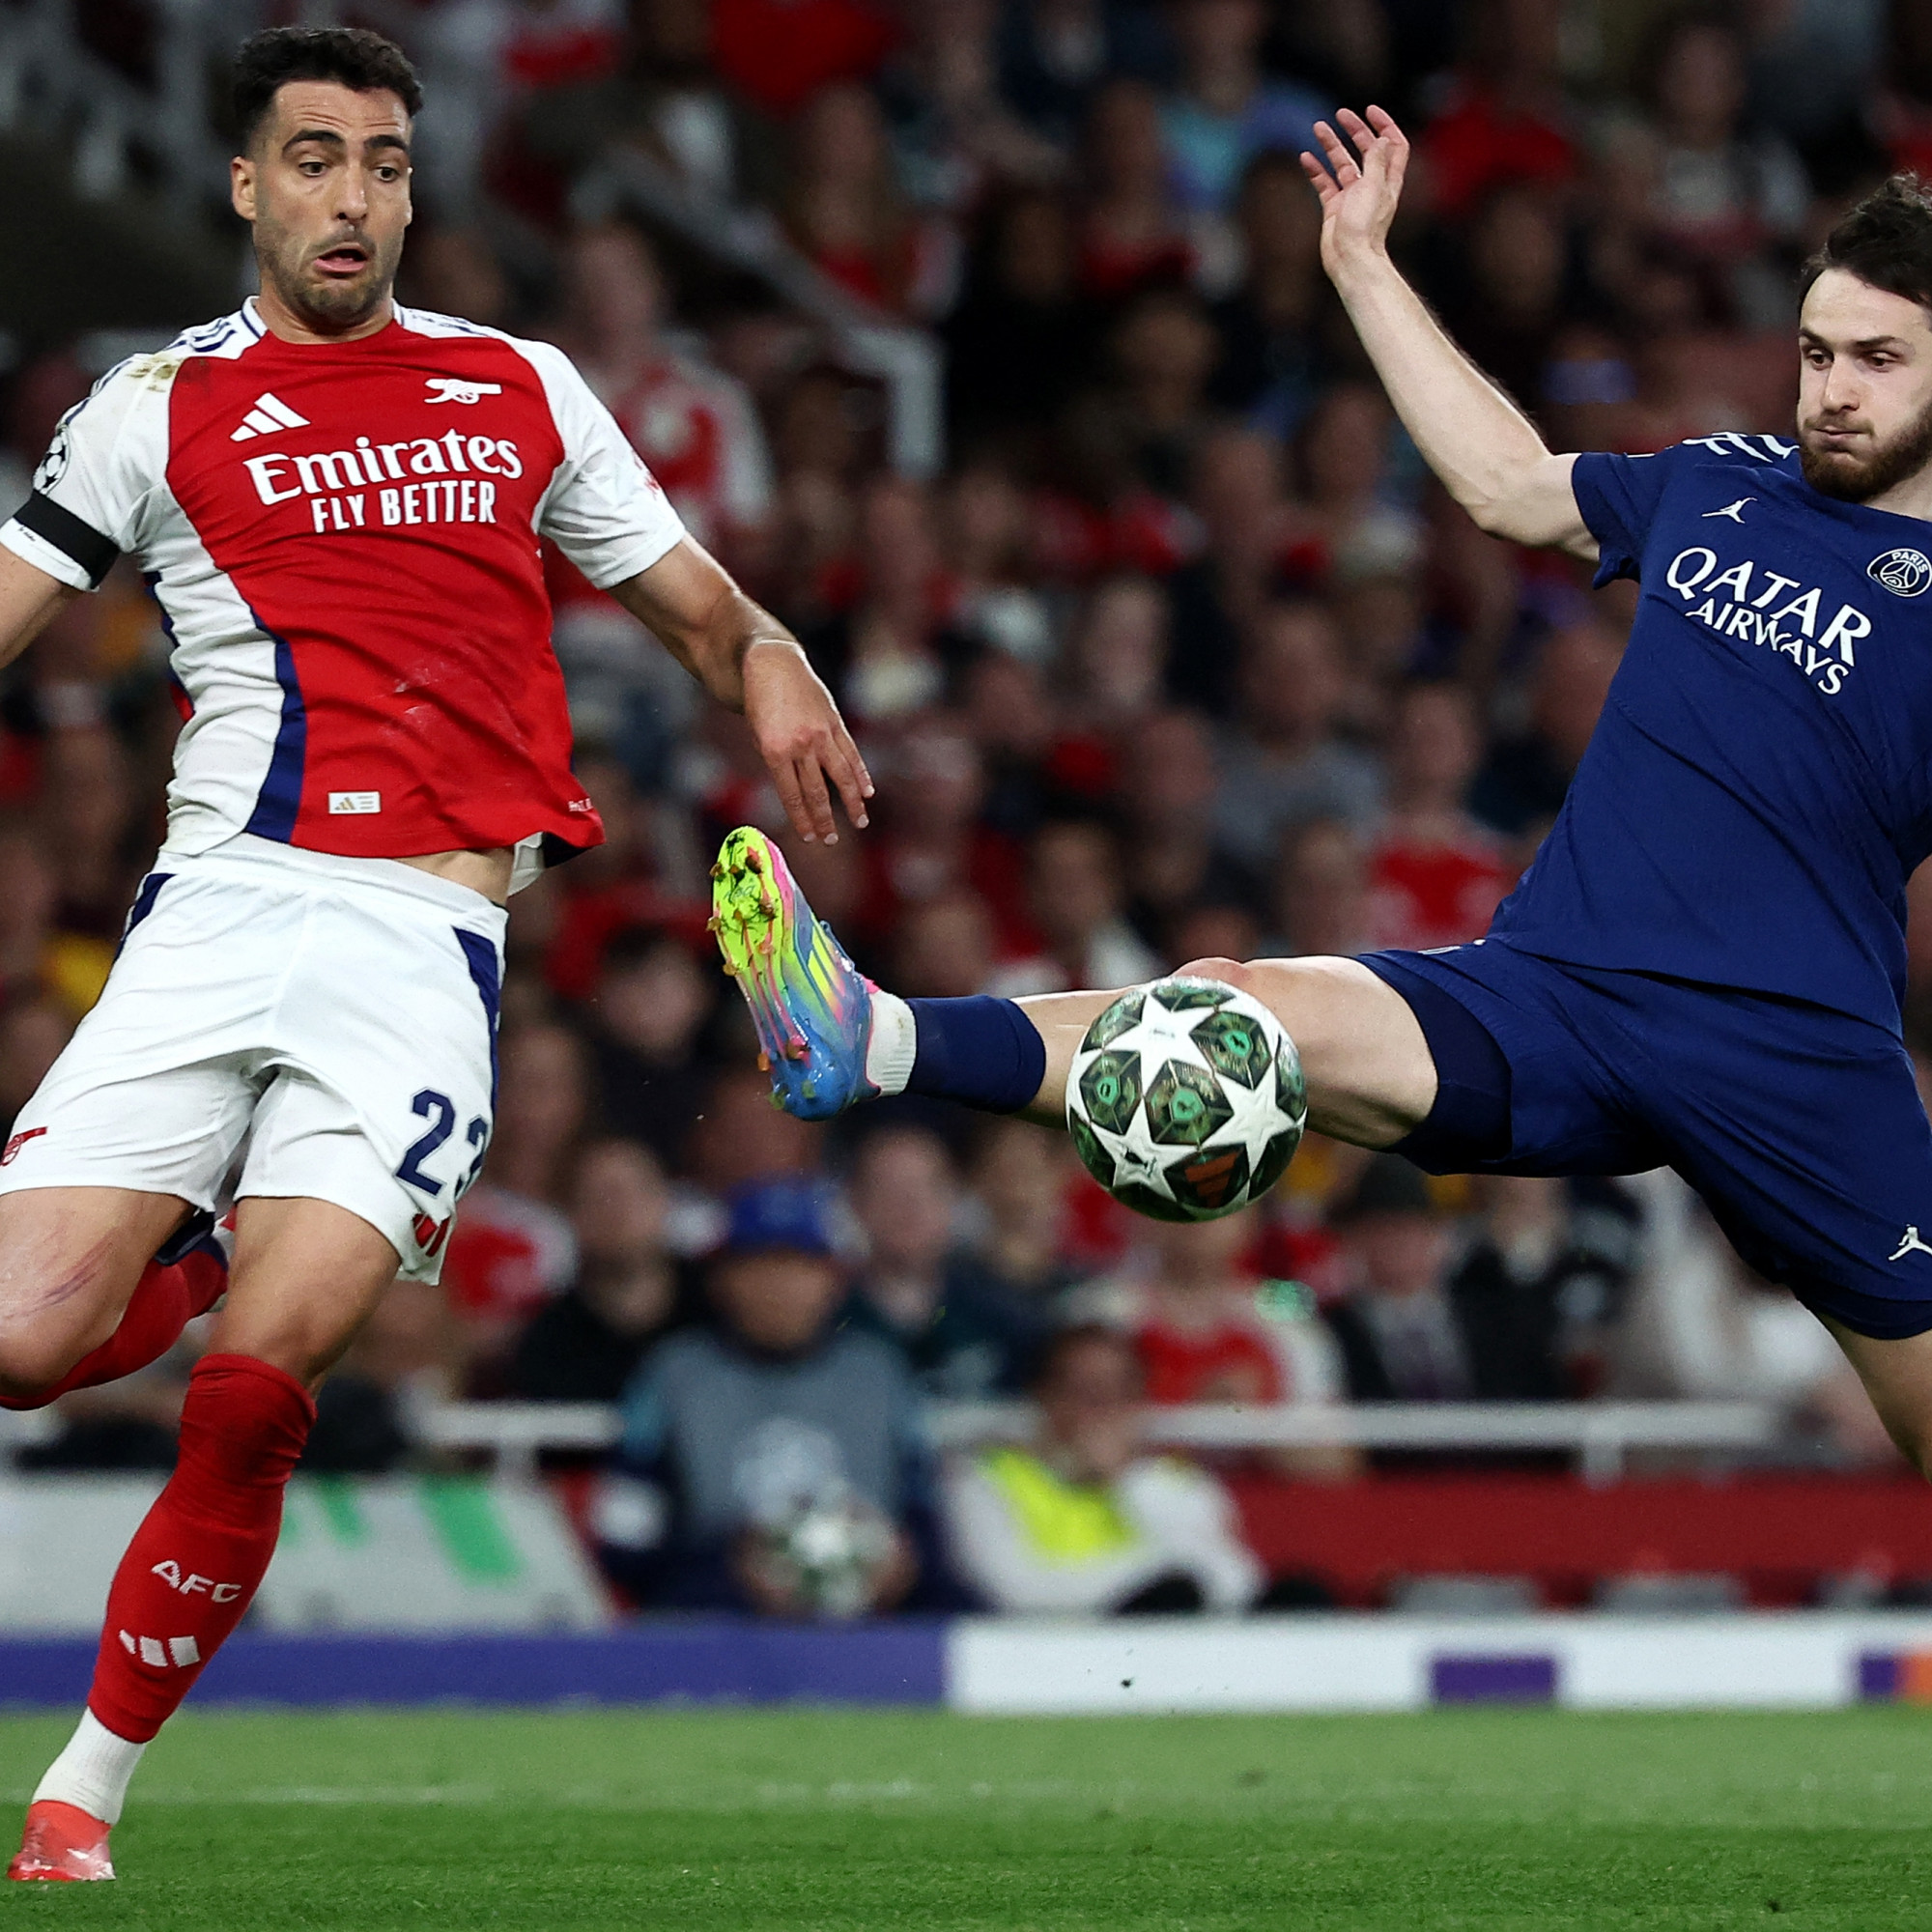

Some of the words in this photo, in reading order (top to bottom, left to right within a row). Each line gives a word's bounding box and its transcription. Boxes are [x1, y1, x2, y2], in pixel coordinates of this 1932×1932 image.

[242, 428, 524, 505] Emirates
[310, 494, 365, 533] FLY
[380, 480, 497, 526] BETTER
[1891, 552, 1928, 574] PARIS
[1666, 547, 1872, 667] QATAR
[1685, 598, 1849, 695] AIRWAYS
[151, 1560, 242, 1603] AFC
